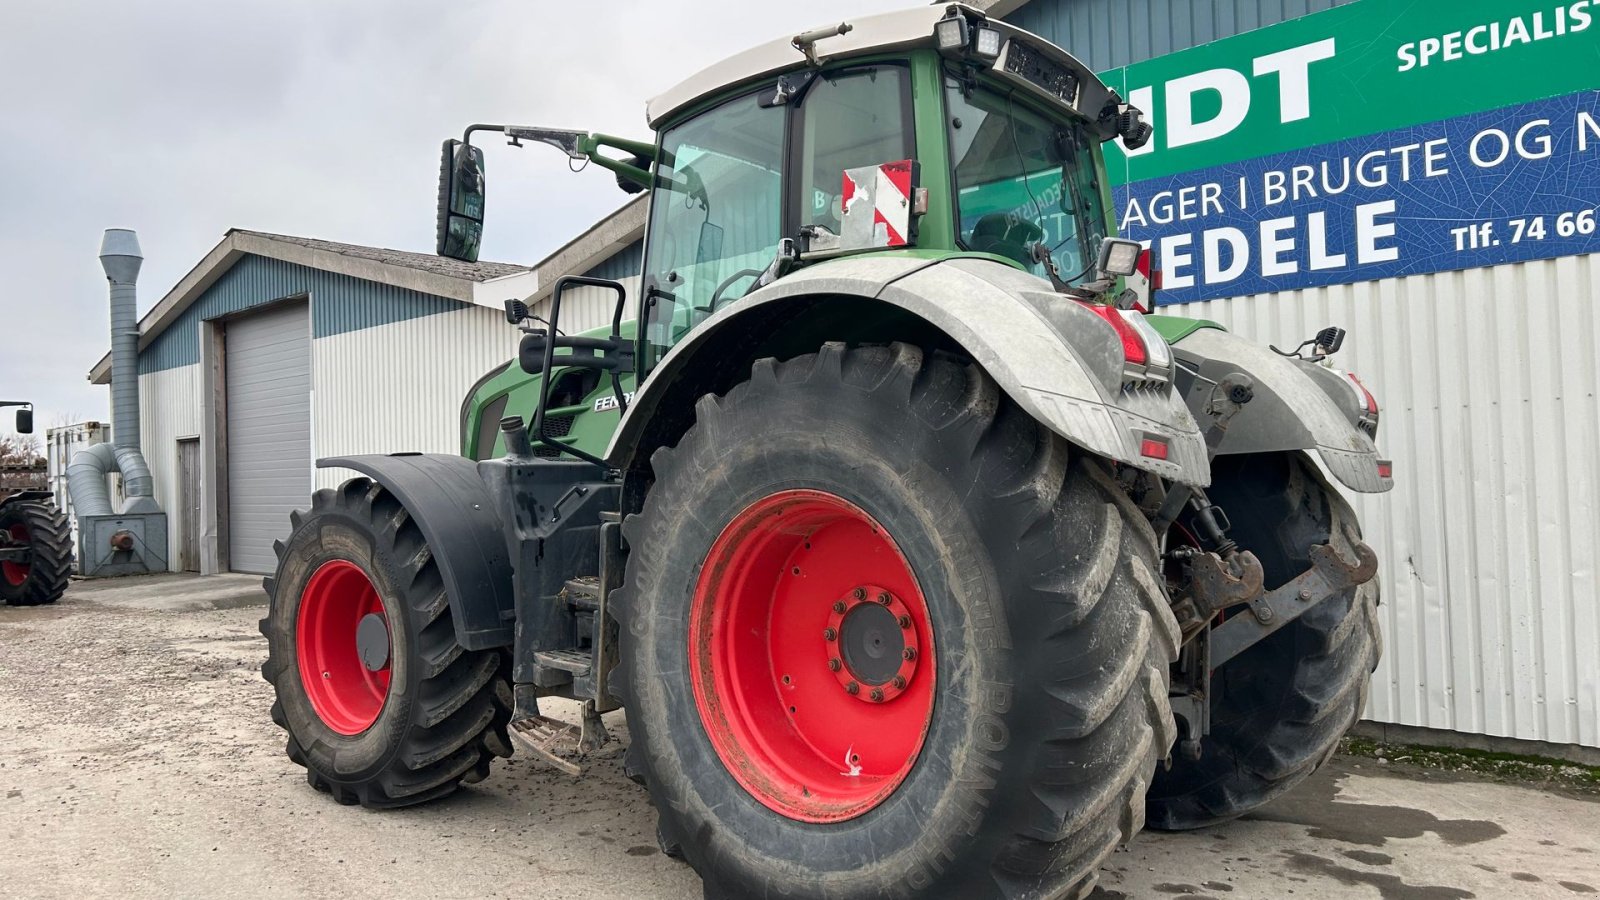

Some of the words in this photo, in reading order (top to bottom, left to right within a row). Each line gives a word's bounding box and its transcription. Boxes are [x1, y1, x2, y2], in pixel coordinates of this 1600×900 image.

[1397, 0, 1600, 72] SPECIALIS
[1117, 182, 1224, 231] AGER
[1240, 177, 1247, 210] I
[1264, 138, 1449, 206] BRUGTE
[1469, 119, 1552, 168] OG
[1138, 199, 1399, 291] EDELE
[1450, 221, 1499, 252] Tlf.
[1509, 216, 1546, 244] 74
[1556, 209, 1596, 238] 66
